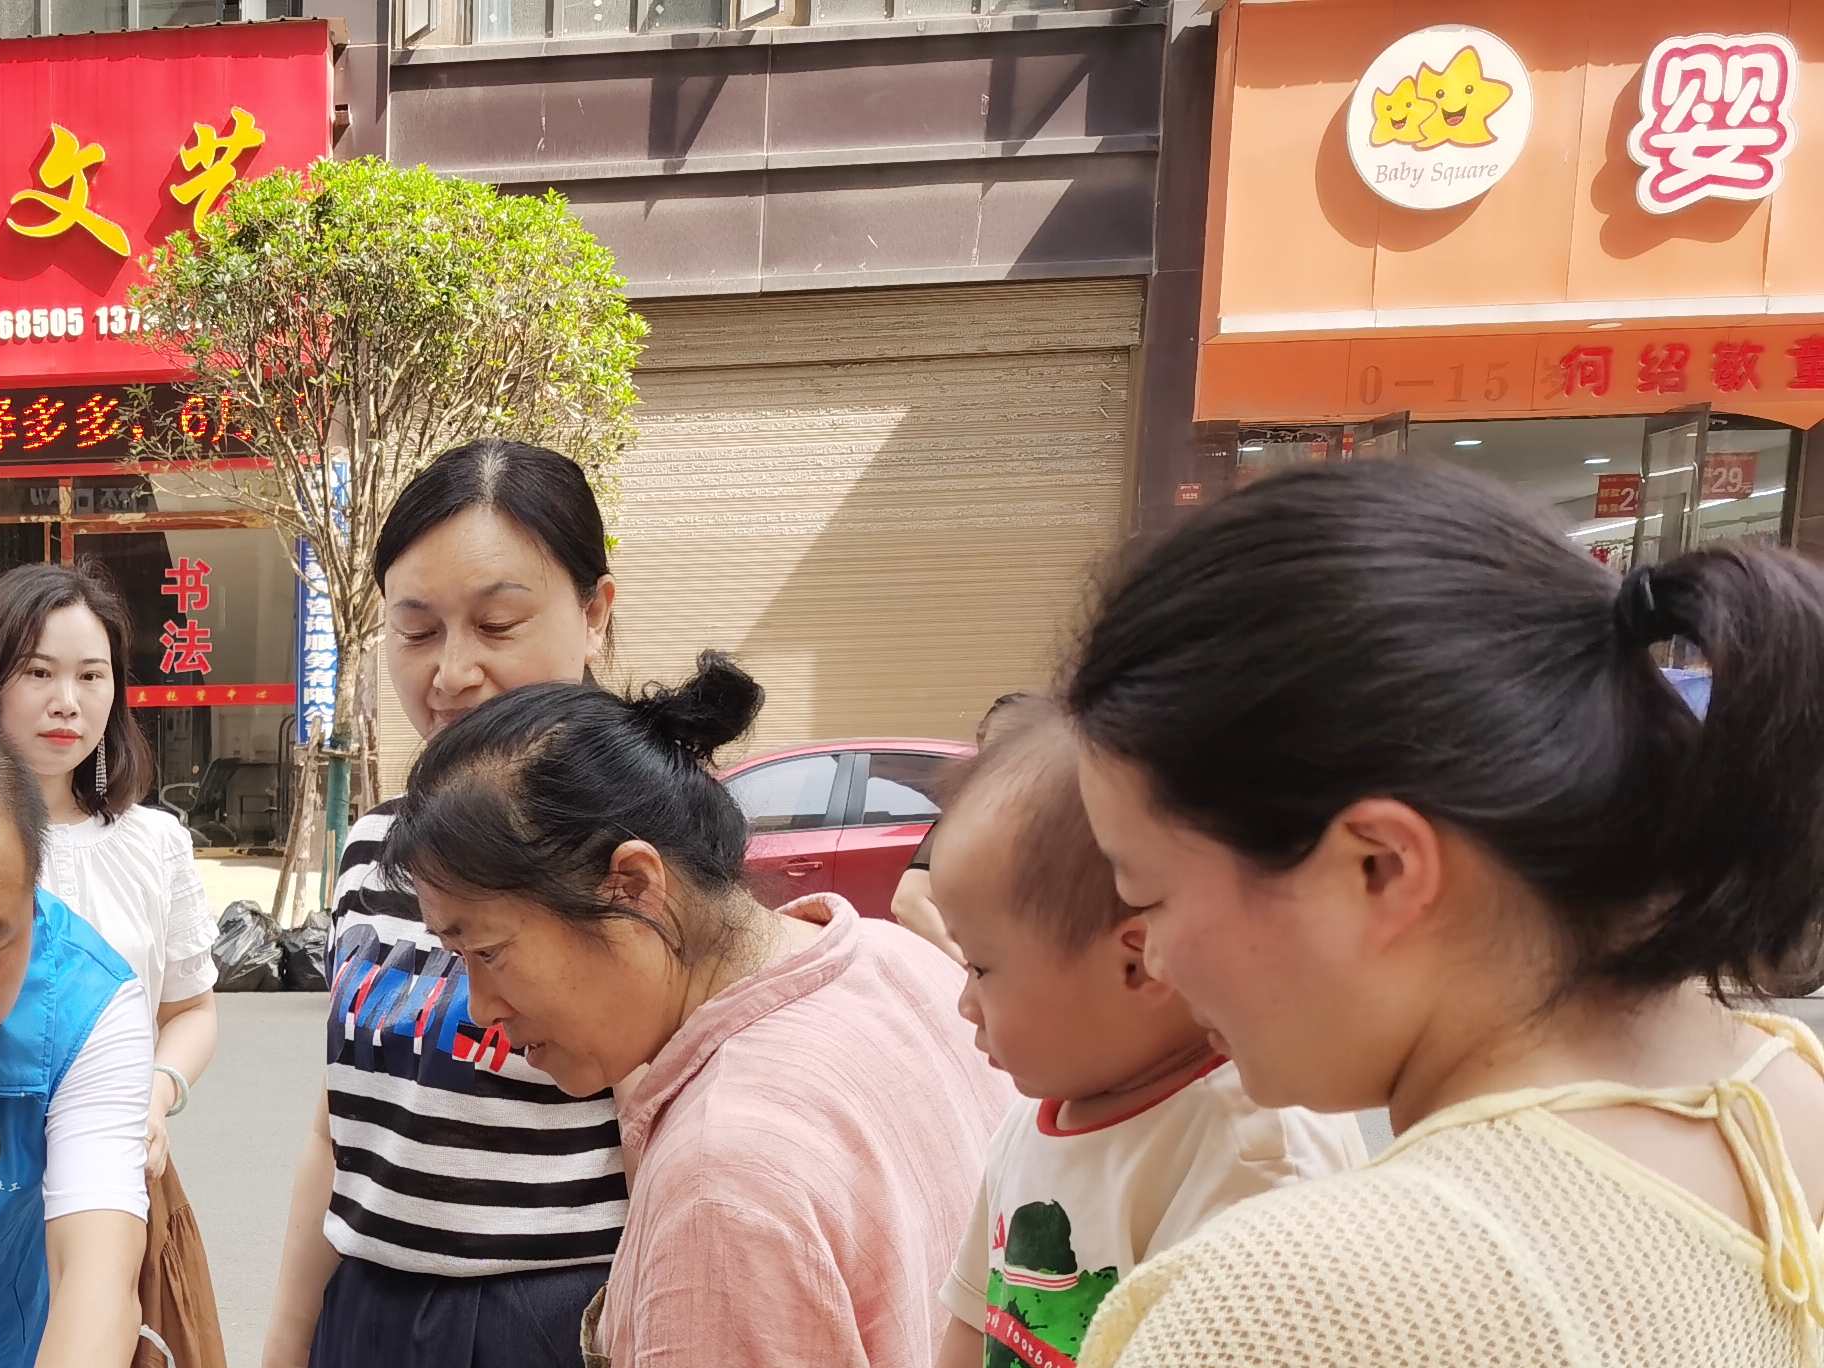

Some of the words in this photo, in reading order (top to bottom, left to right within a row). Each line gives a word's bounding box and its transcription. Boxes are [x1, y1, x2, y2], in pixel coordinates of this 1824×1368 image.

[1375, 162, 1423, 187] Baby
[1430, 158, 1499, 185] Square
[1639, 42, 1790, 208] 婴
[160, 557, 213, 675] 书法
